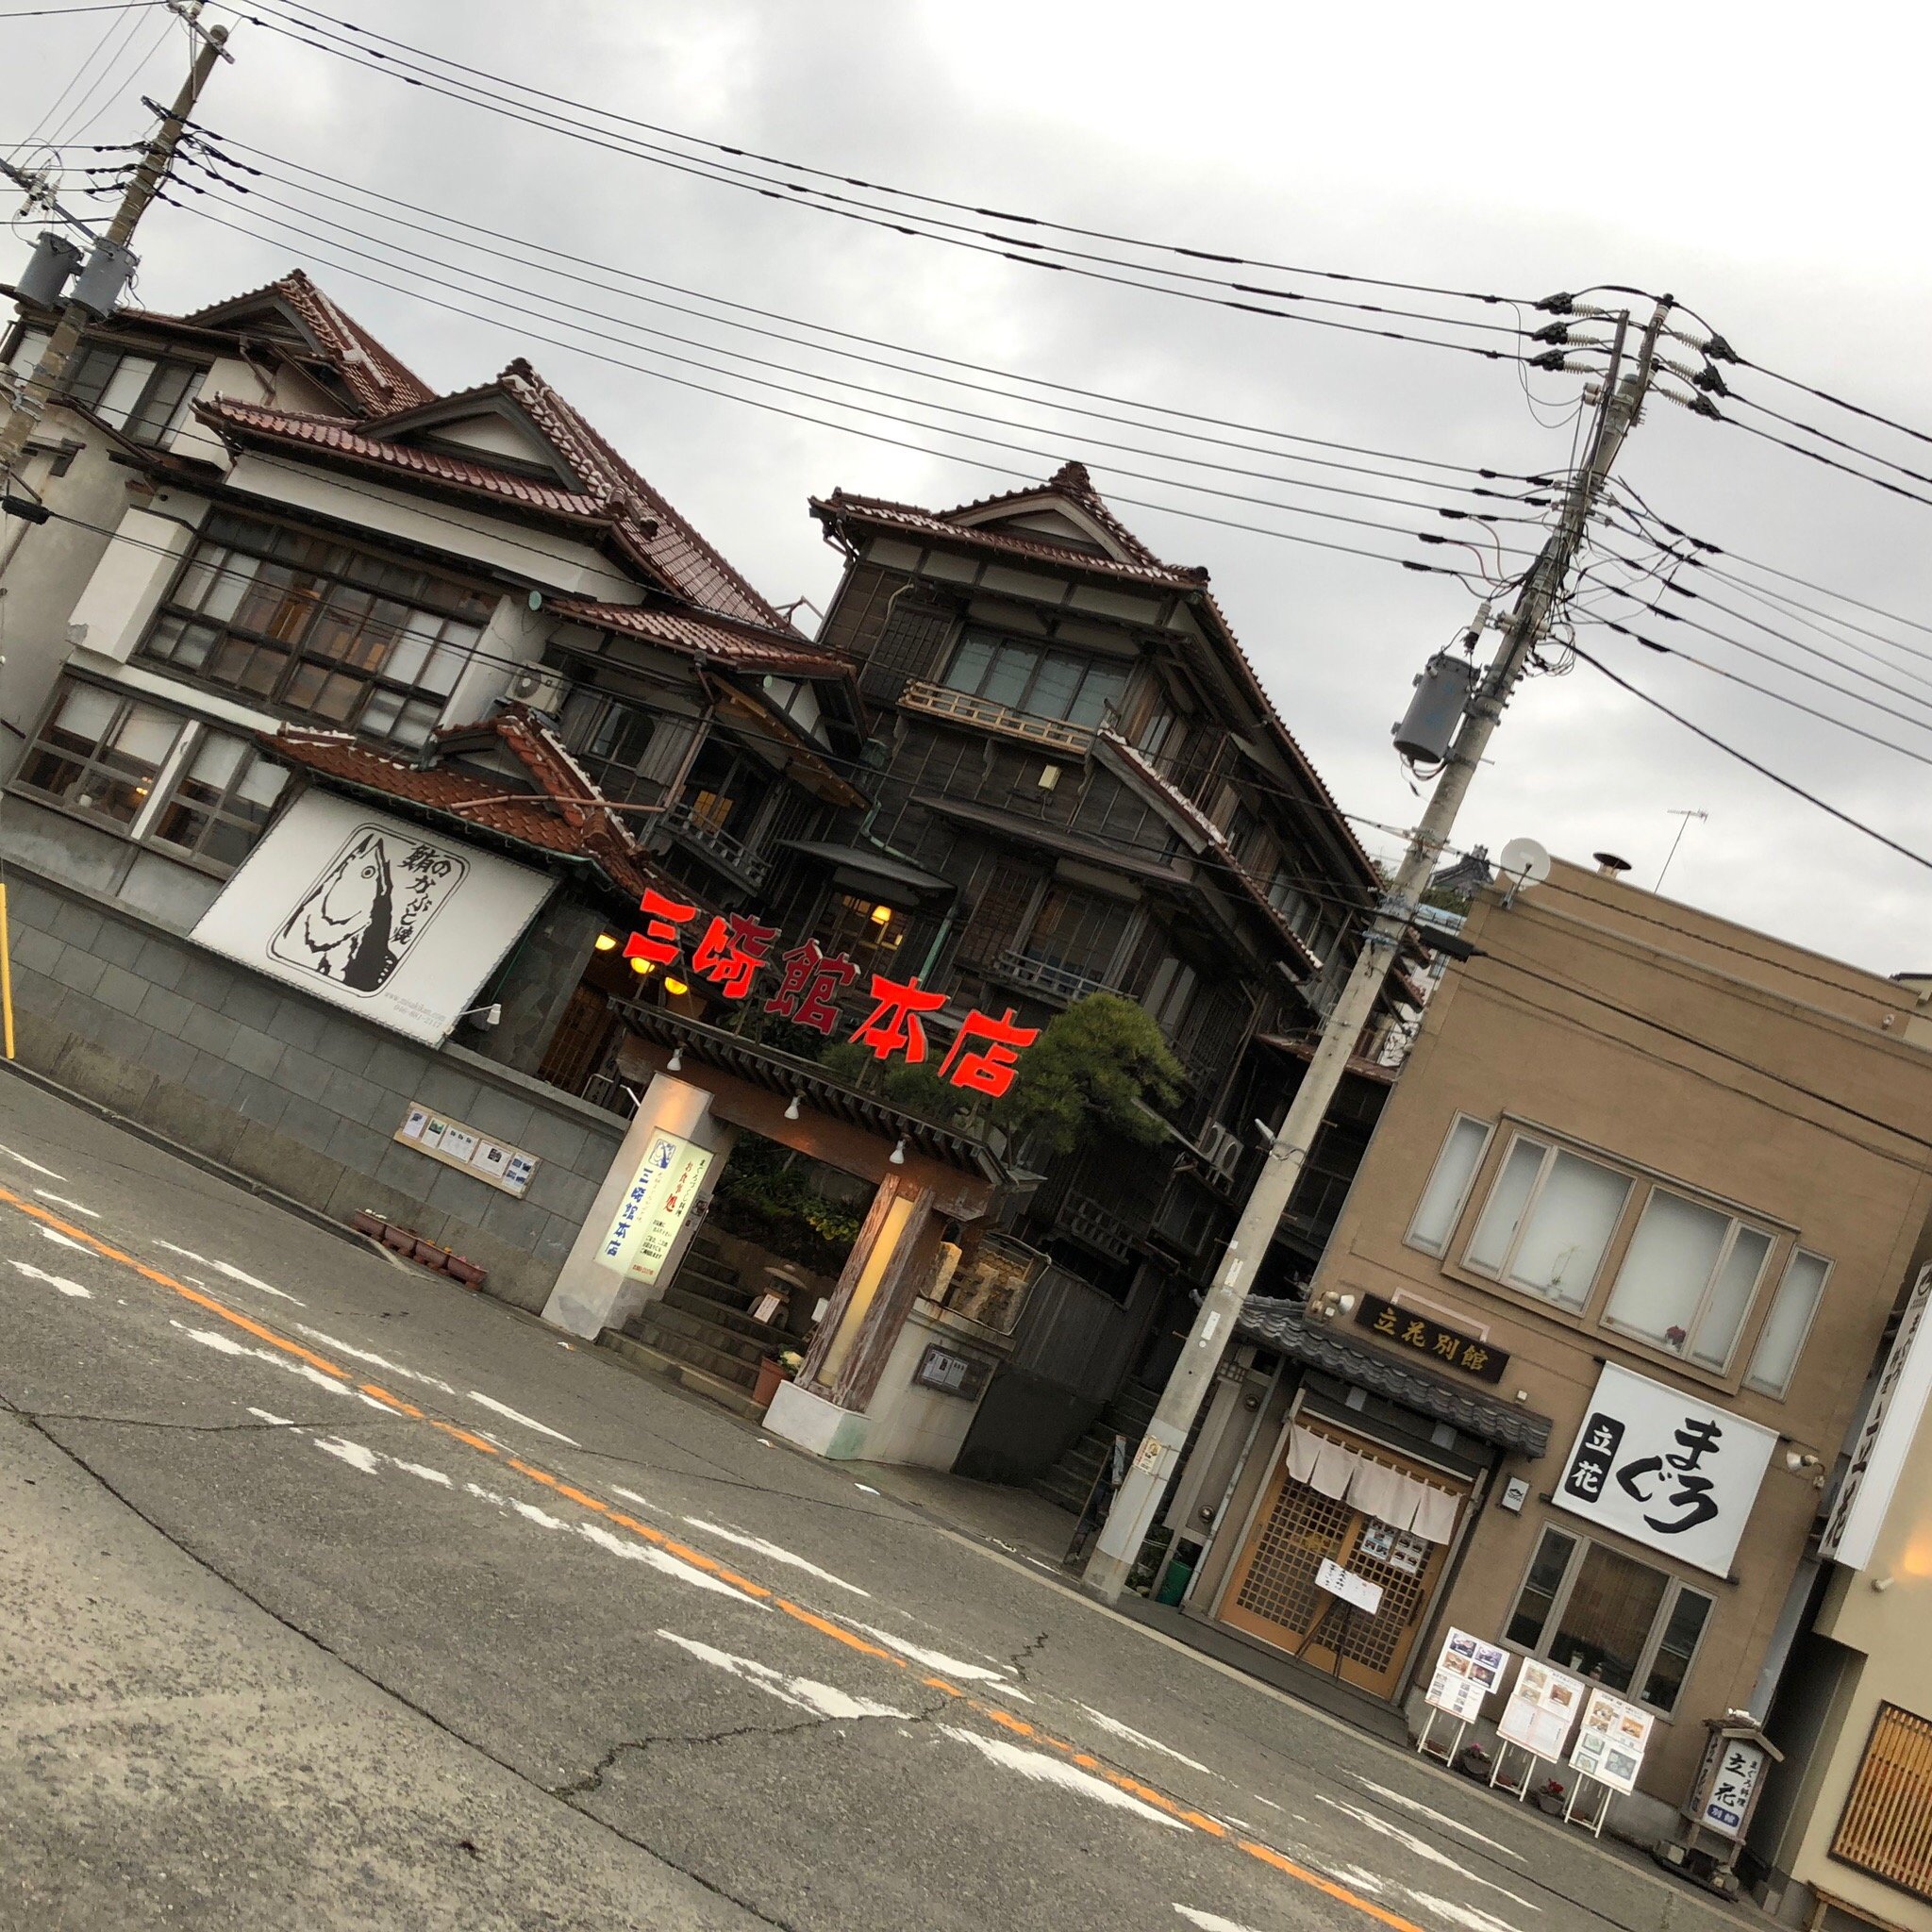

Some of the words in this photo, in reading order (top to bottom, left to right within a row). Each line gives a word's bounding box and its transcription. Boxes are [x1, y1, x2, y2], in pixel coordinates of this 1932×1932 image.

[623, 888, 1040, 1097] 三崎館本店
[605, 1168, 653, 1257] 三崎館本店
[1374, 1308, 1489, 1371] 立花別館
[1571, 1424, 1613, 1493] 立花
[1616, 1417, 1723, 1534] まぐろ
[1714, 1752, 1746, 1807] 立花
